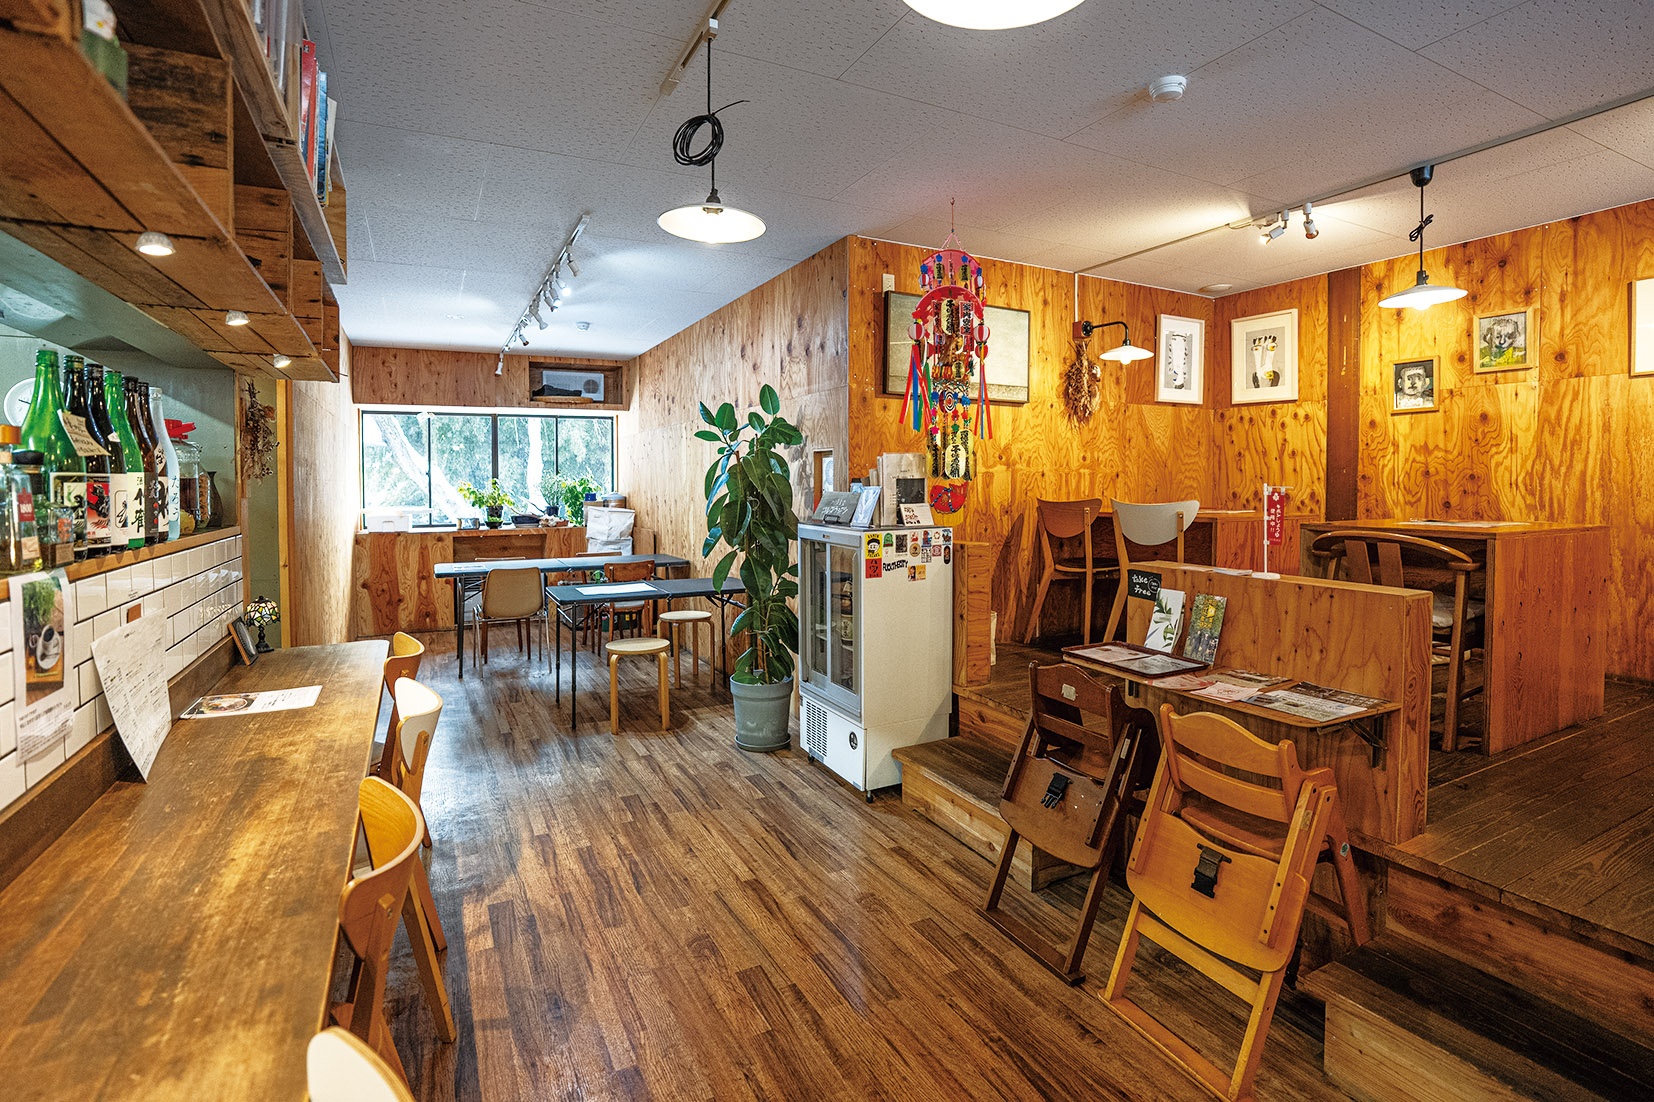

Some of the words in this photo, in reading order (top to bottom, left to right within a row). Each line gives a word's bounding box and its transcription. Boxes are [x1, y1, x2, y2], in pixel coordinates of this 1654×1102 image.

[171, 475, 180, 522] たろう
[19, 503, 33, 513] 1800
[1132, 574, 1148, 584] take
[1134, 584, 1151, 596] free
